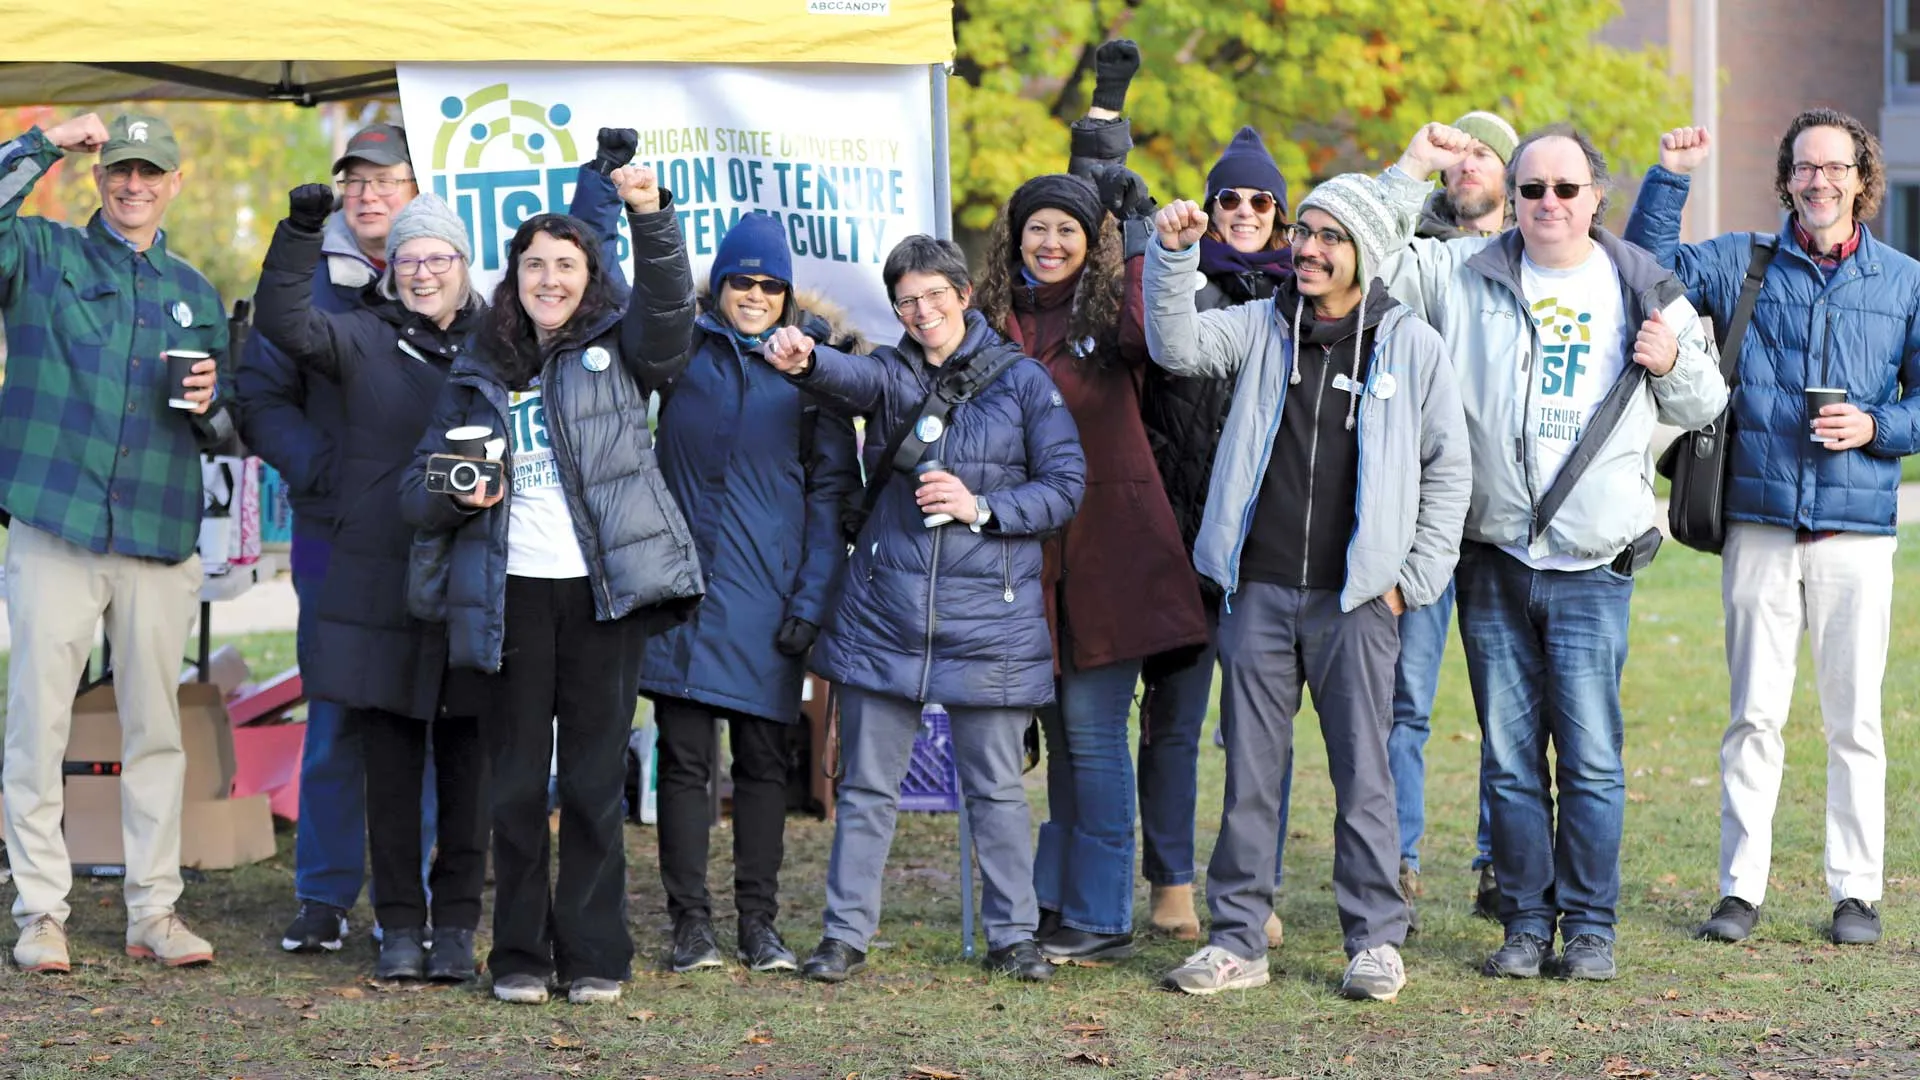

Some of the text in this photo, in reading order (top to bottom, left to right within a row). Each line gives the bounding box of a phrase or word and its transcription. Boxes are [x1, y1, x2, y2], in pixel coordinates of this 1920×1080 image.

[810, 1, 887, 12] ABCCANOPY
[635, 127, 709, 156] HIGAN
[715, 127, 772, 157] STATE
[629, 157, 905, 215] ION OF TENURE
[1541, 407, 1582, 426] TENURE
[1538, 422, 1581, 442] ACULTY
